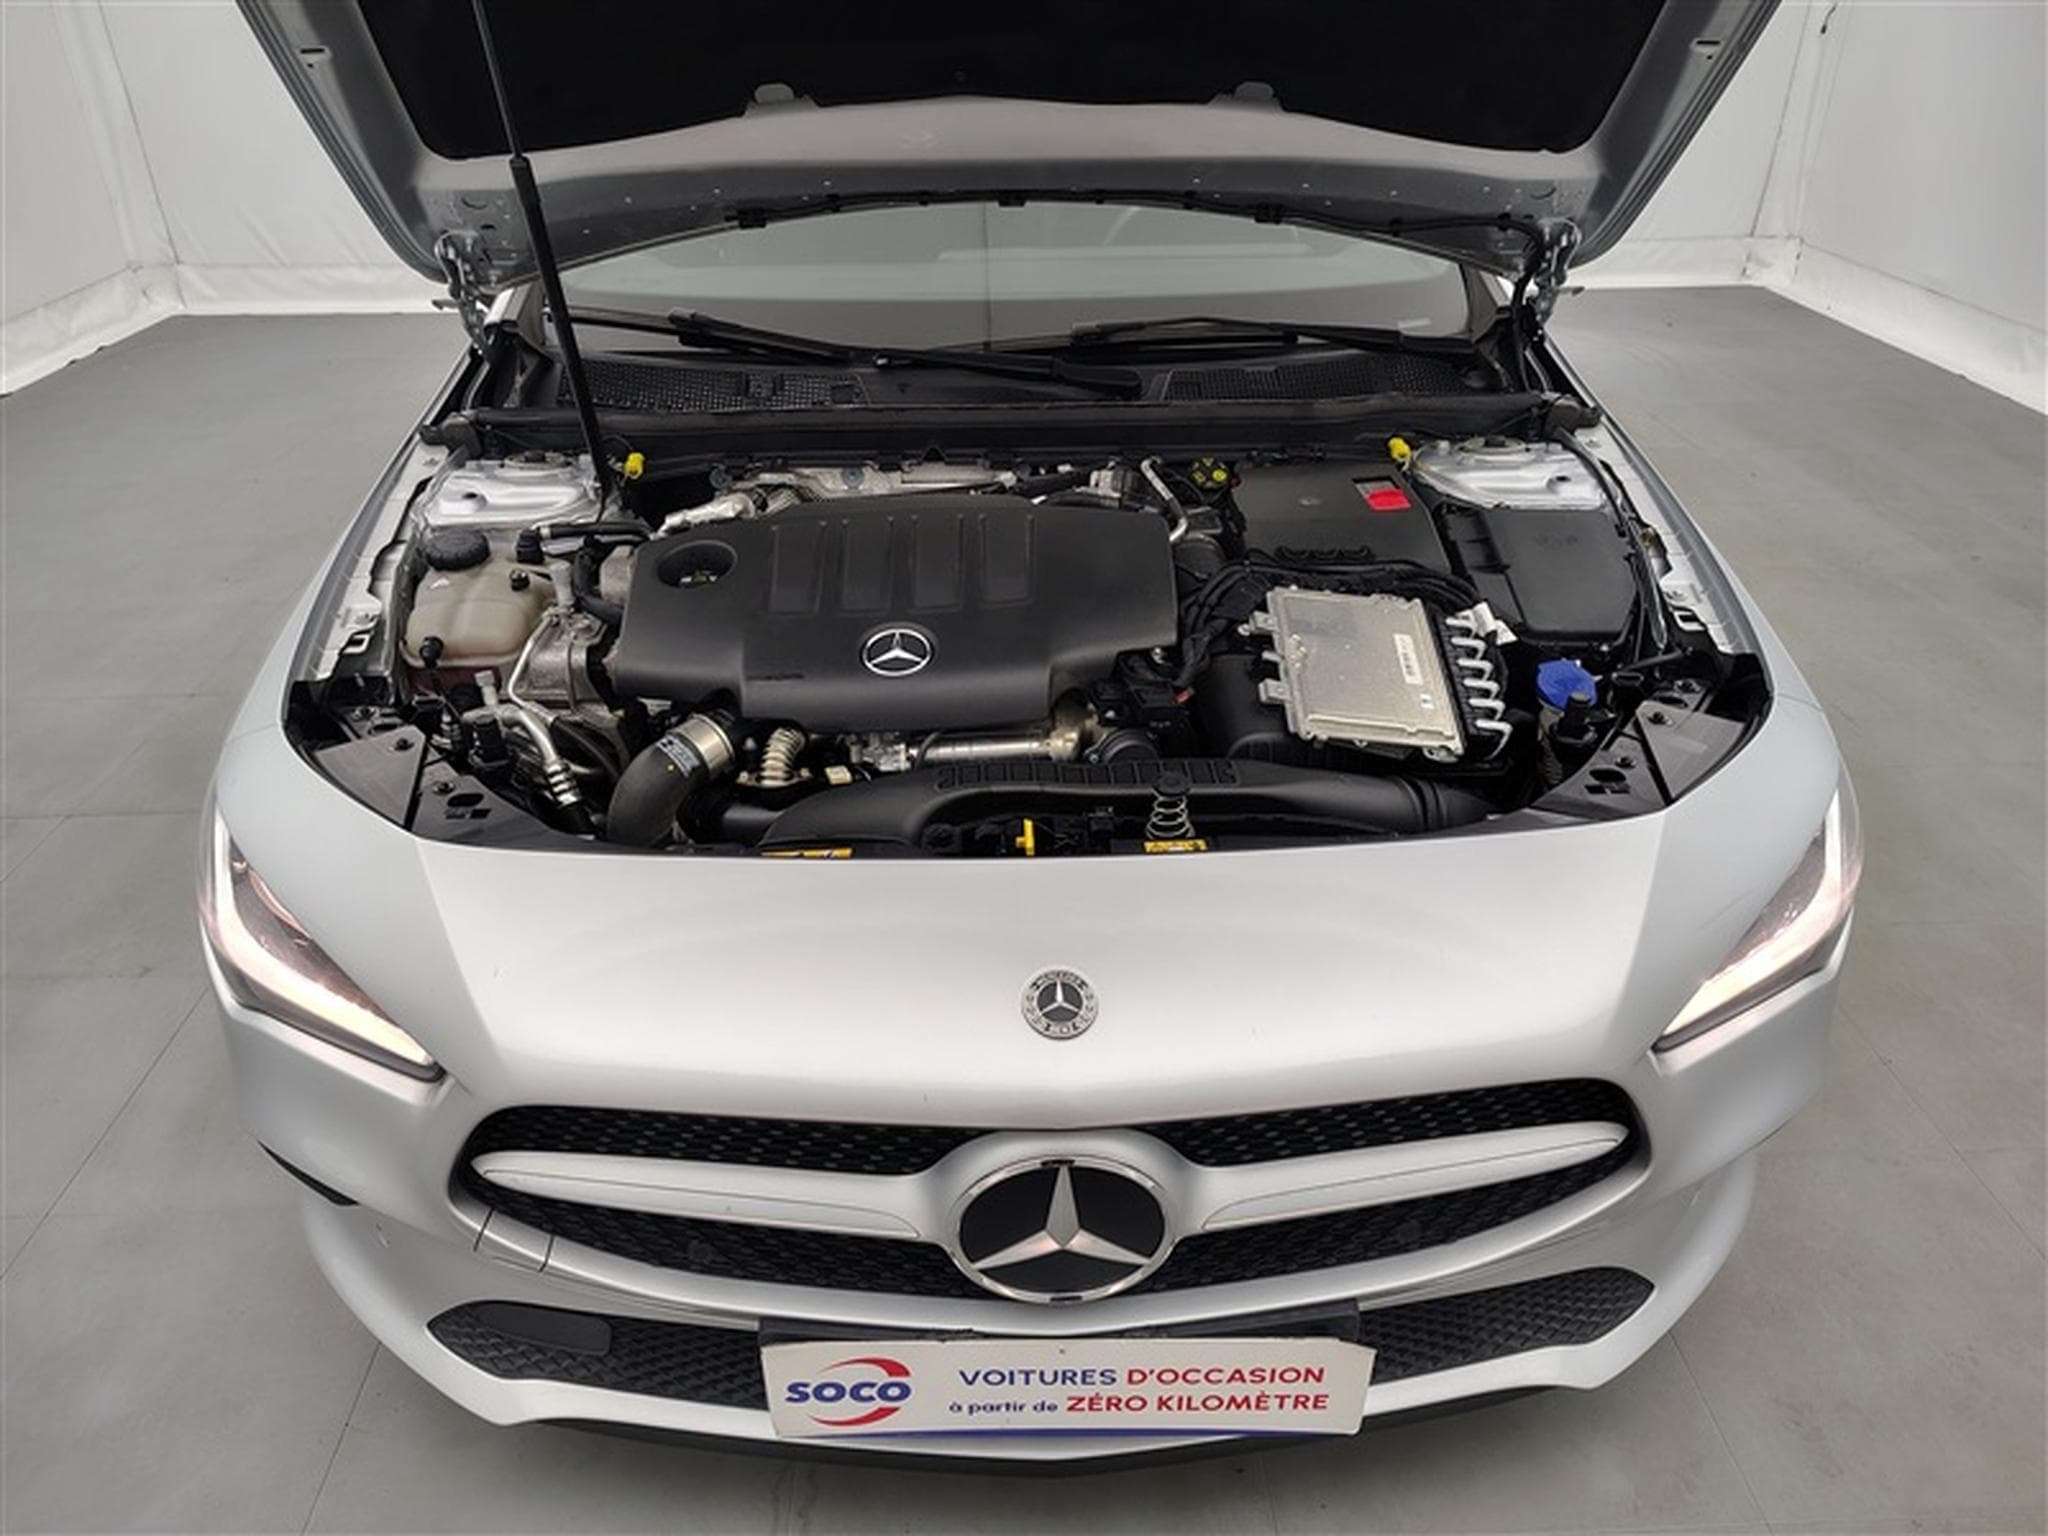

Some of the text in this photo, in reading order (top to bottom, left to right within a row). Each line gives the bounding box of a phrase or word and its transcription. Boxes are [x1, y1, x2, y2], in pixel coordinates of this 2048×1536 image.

[958, 1367, 1325, 1386] VOITURES D'OCCASION
[785, 1381, 912, 1402] SOCO
[949, 1390, 1329, 1416] à partir de ZÉRO KILOMÈTRE
